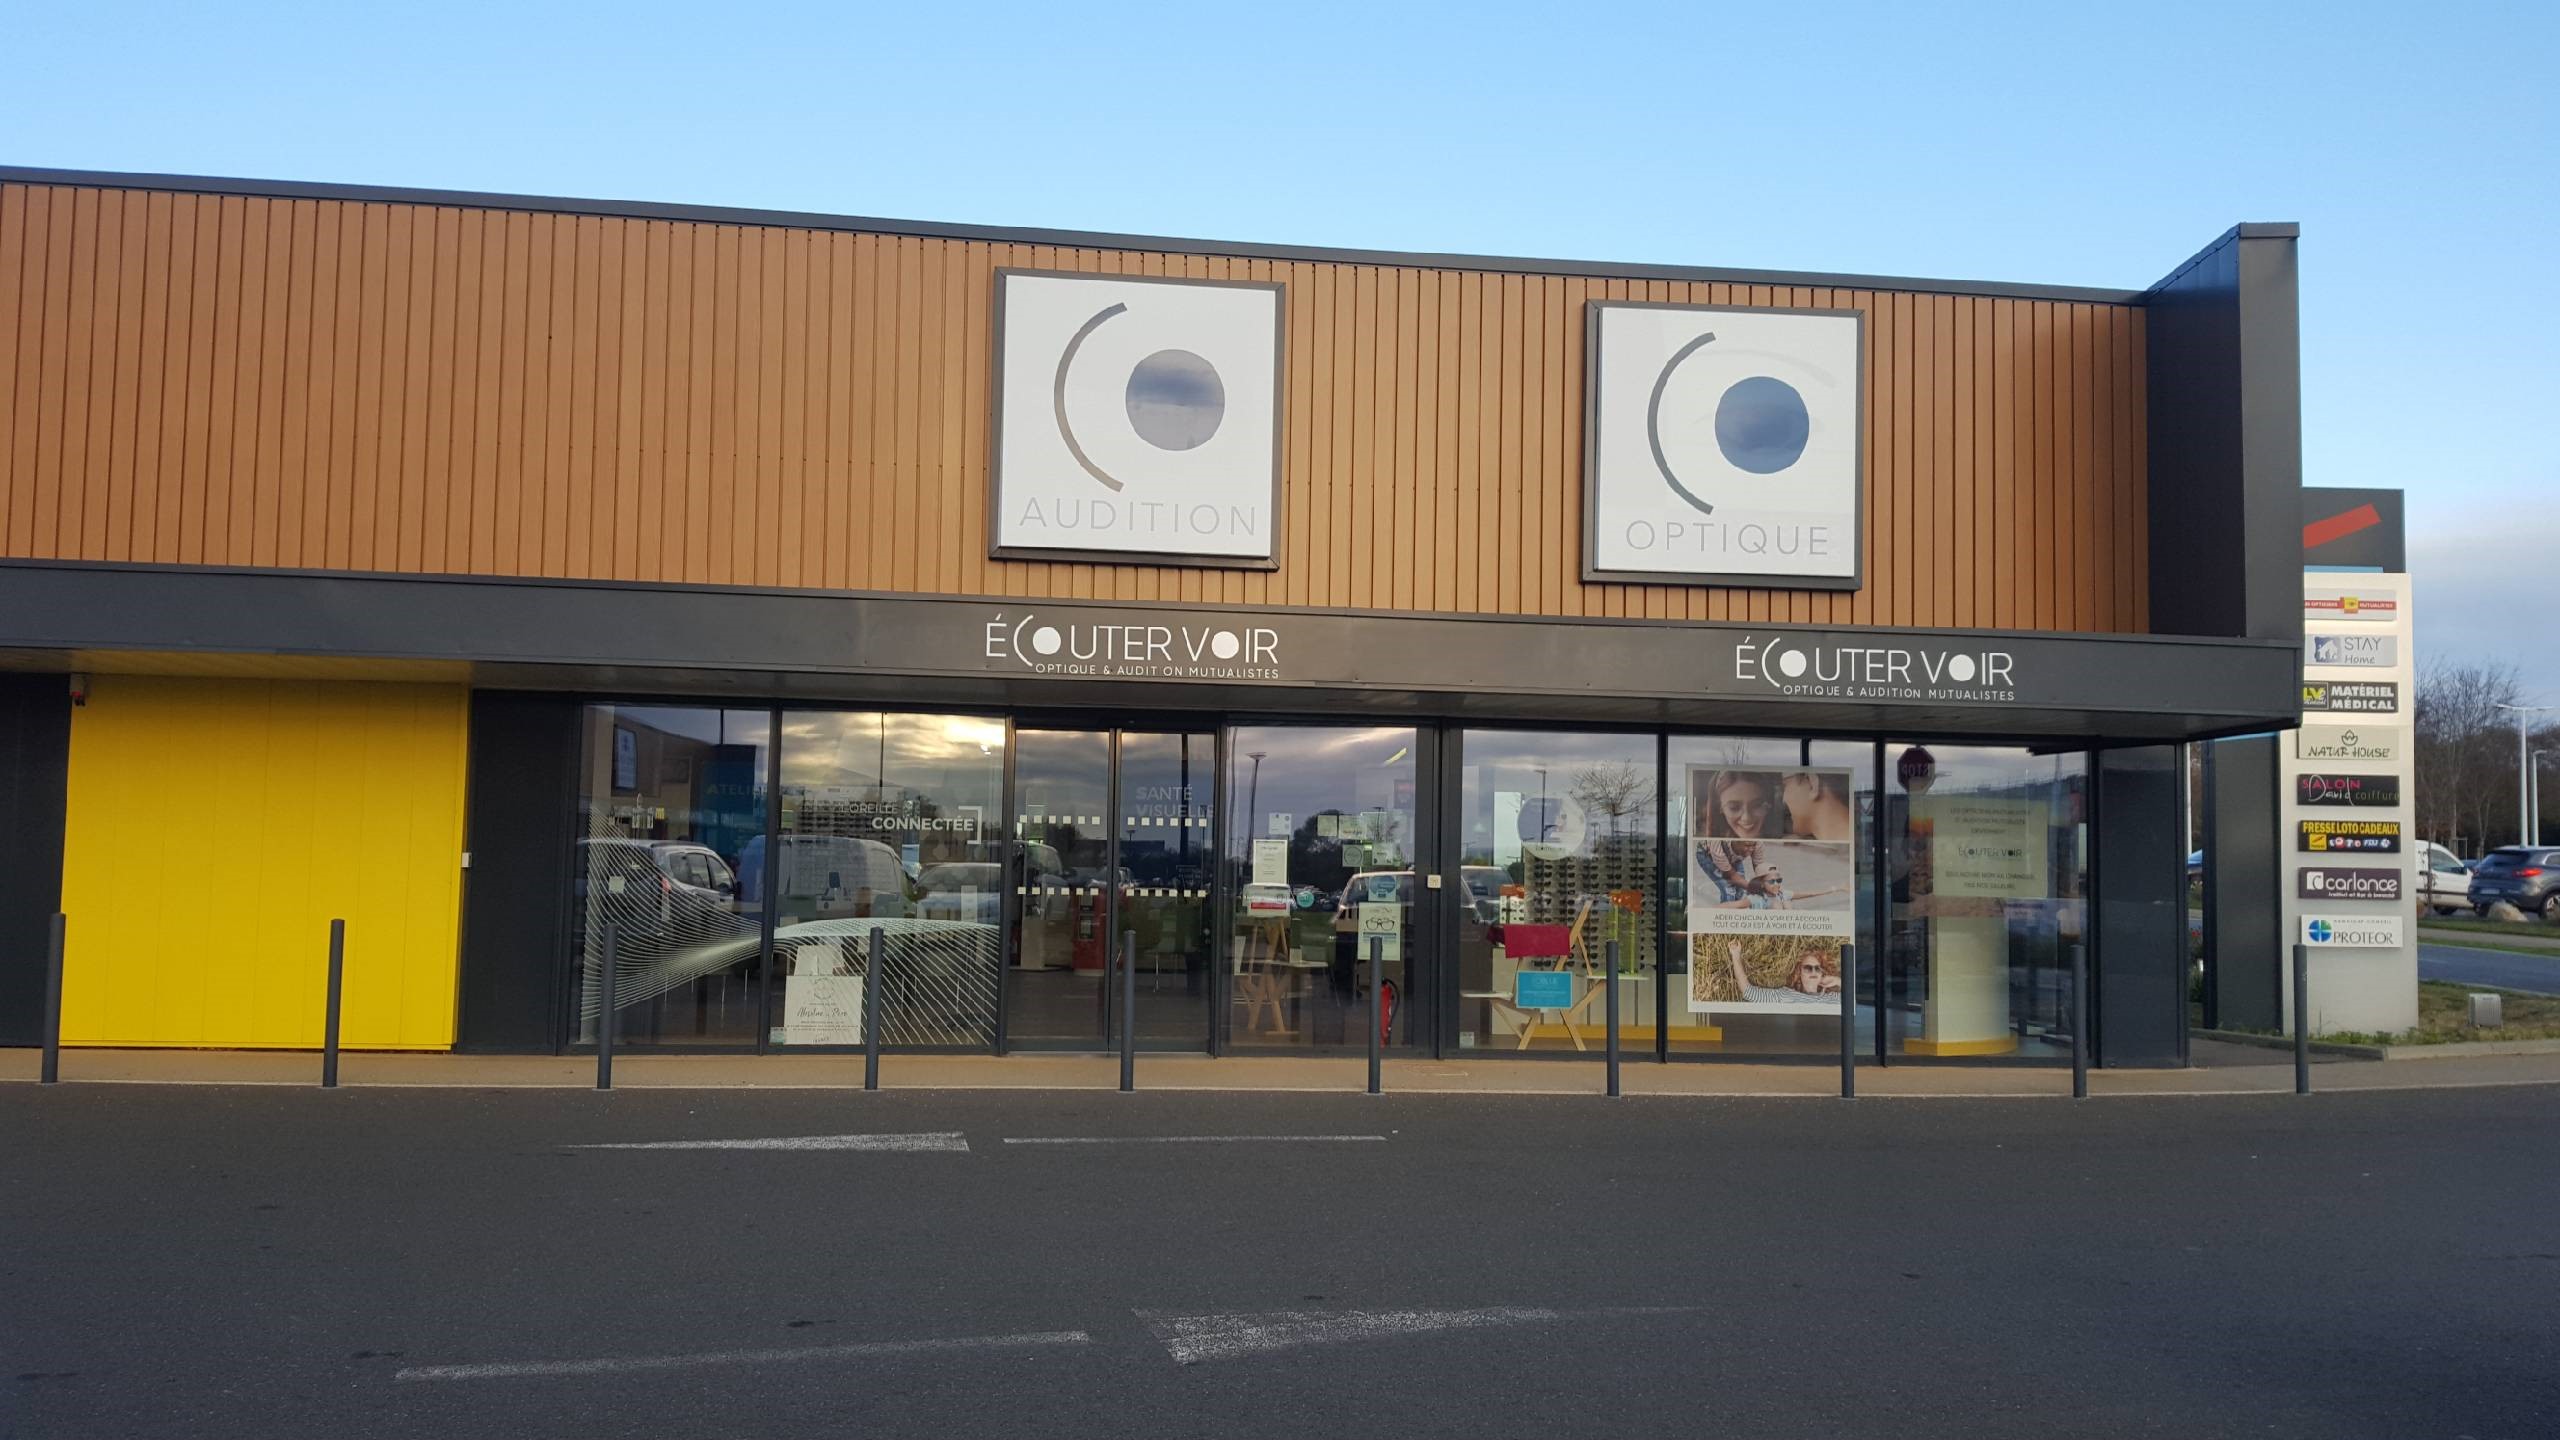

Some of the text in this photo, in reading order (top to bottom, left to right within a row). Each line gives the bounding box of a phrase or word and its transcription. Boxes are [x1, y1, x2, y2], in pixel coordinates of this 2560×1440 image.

[1019, 497, 1256, 536] AUDITION
[1625, 520, 1828, 555] OPTIQUE
[986, 613, 1279, 667] ÉCOUTER VOIR
[2344, 637, 2382, 651] STAY
[1736, 636, 2014, 688] ÉCOUTER VOIR
[2344, 655, 2376, 664] Home
[1035, 663, 1097, 676] OPTIQUE
[1103, 665, 1110, 675] &
[1188, 667, 1280, 680] MUTUALISTES
[1783, 685, 2015, 701] OPTIQUE & AUDITION MUTUALISTES
[2331, 682, 2395, 698] MATÉRIEL
[2331, 695, 2395, 710] MÉDICAL
[2308, 745, 2391, 758] NATUR HOUSE
[1136, 783, 1193, 801] SANTÉ
[2303, 779, 2360, 789] SALON
[2308, 775, 2355, 806] David
[1136, 803, 1214, 818] VISUELLE
[872, 815, 975, 832] CONNECTÉE
[2336, 822, 2359, 834] LOTO
[2359, 823, 2399, 835] CADEAUX
[2325, 872, 2397, 892] carlance
[2333, 931, 2394, 945] PROTEOR
